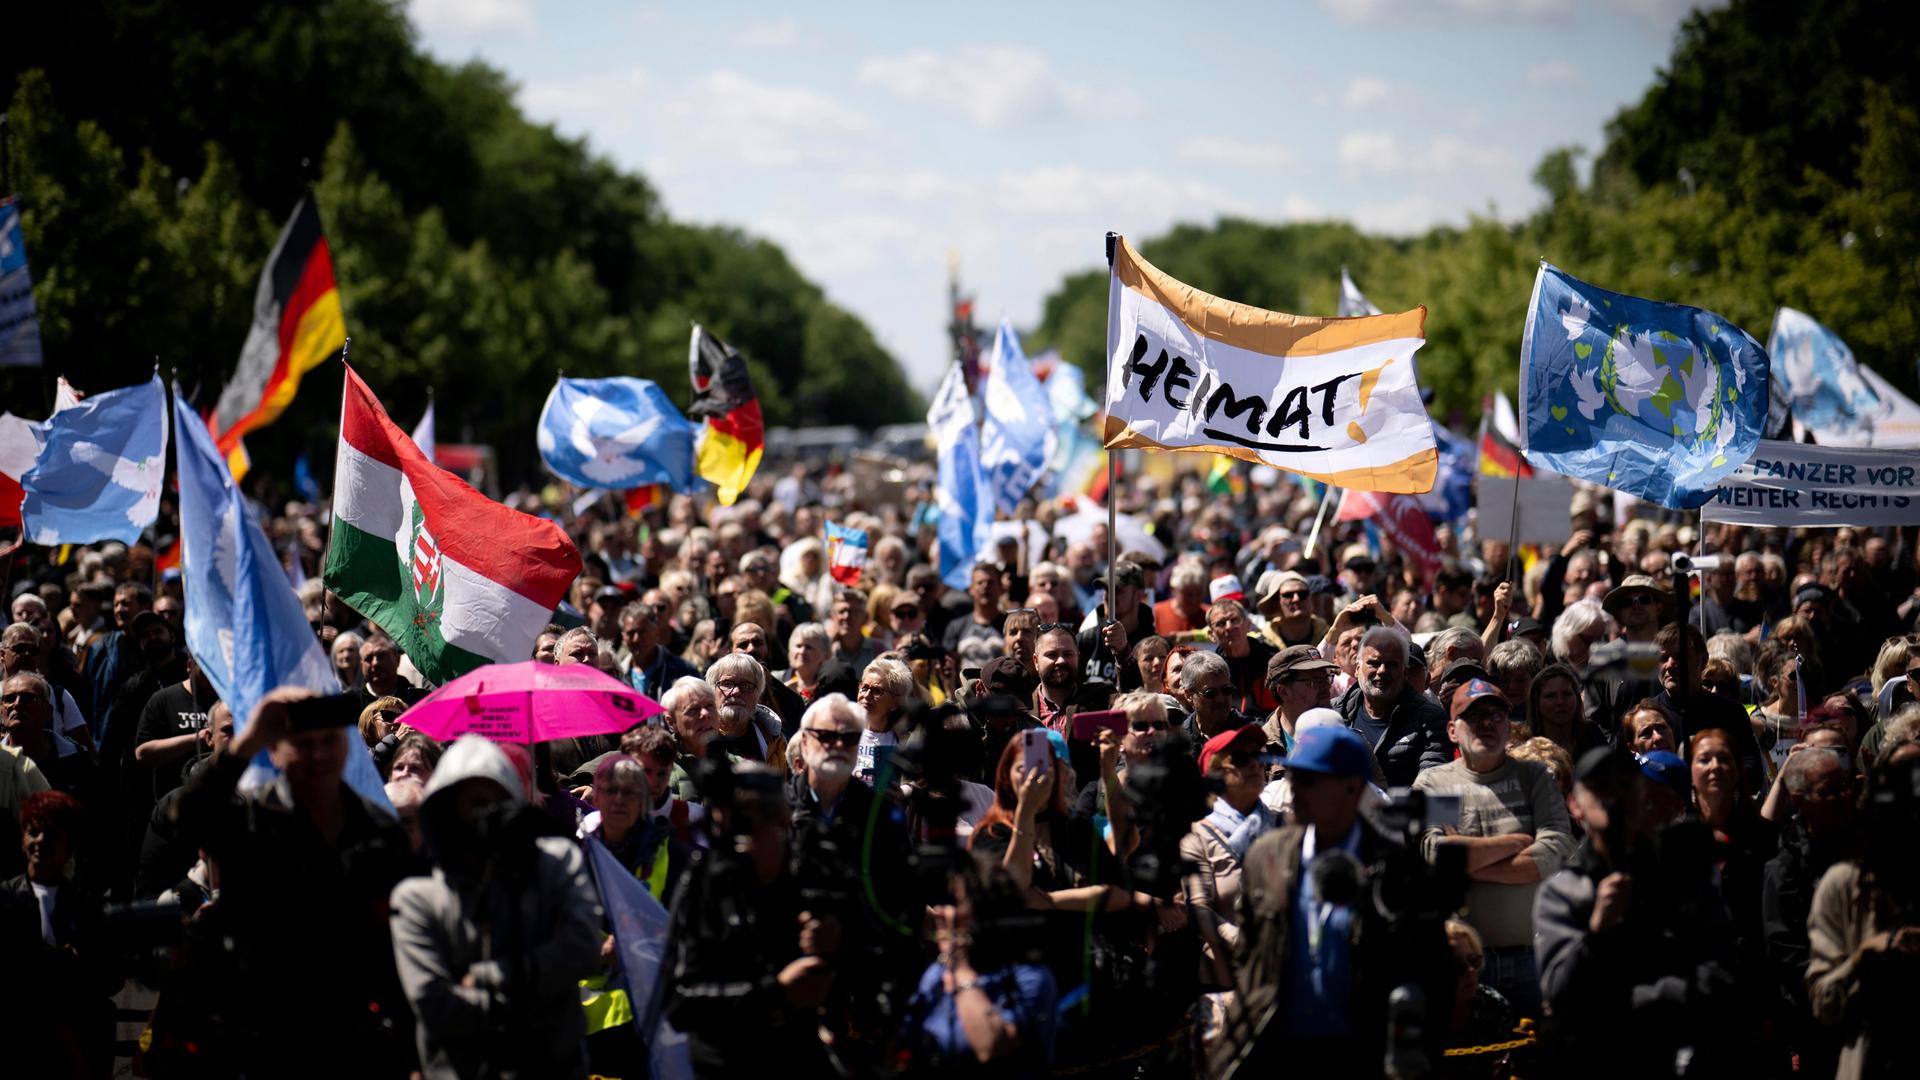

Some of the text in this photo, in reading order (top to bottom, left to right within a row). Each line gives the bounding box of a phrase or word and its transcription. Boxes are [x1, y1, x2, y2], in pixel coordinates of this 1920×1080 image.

[1122, 333, 1394, 445] HEIMAT!
[1753, 459, 1915, 487] PANZER VOR
[1717, 485, 1910, 509] WEITER RECHTS
